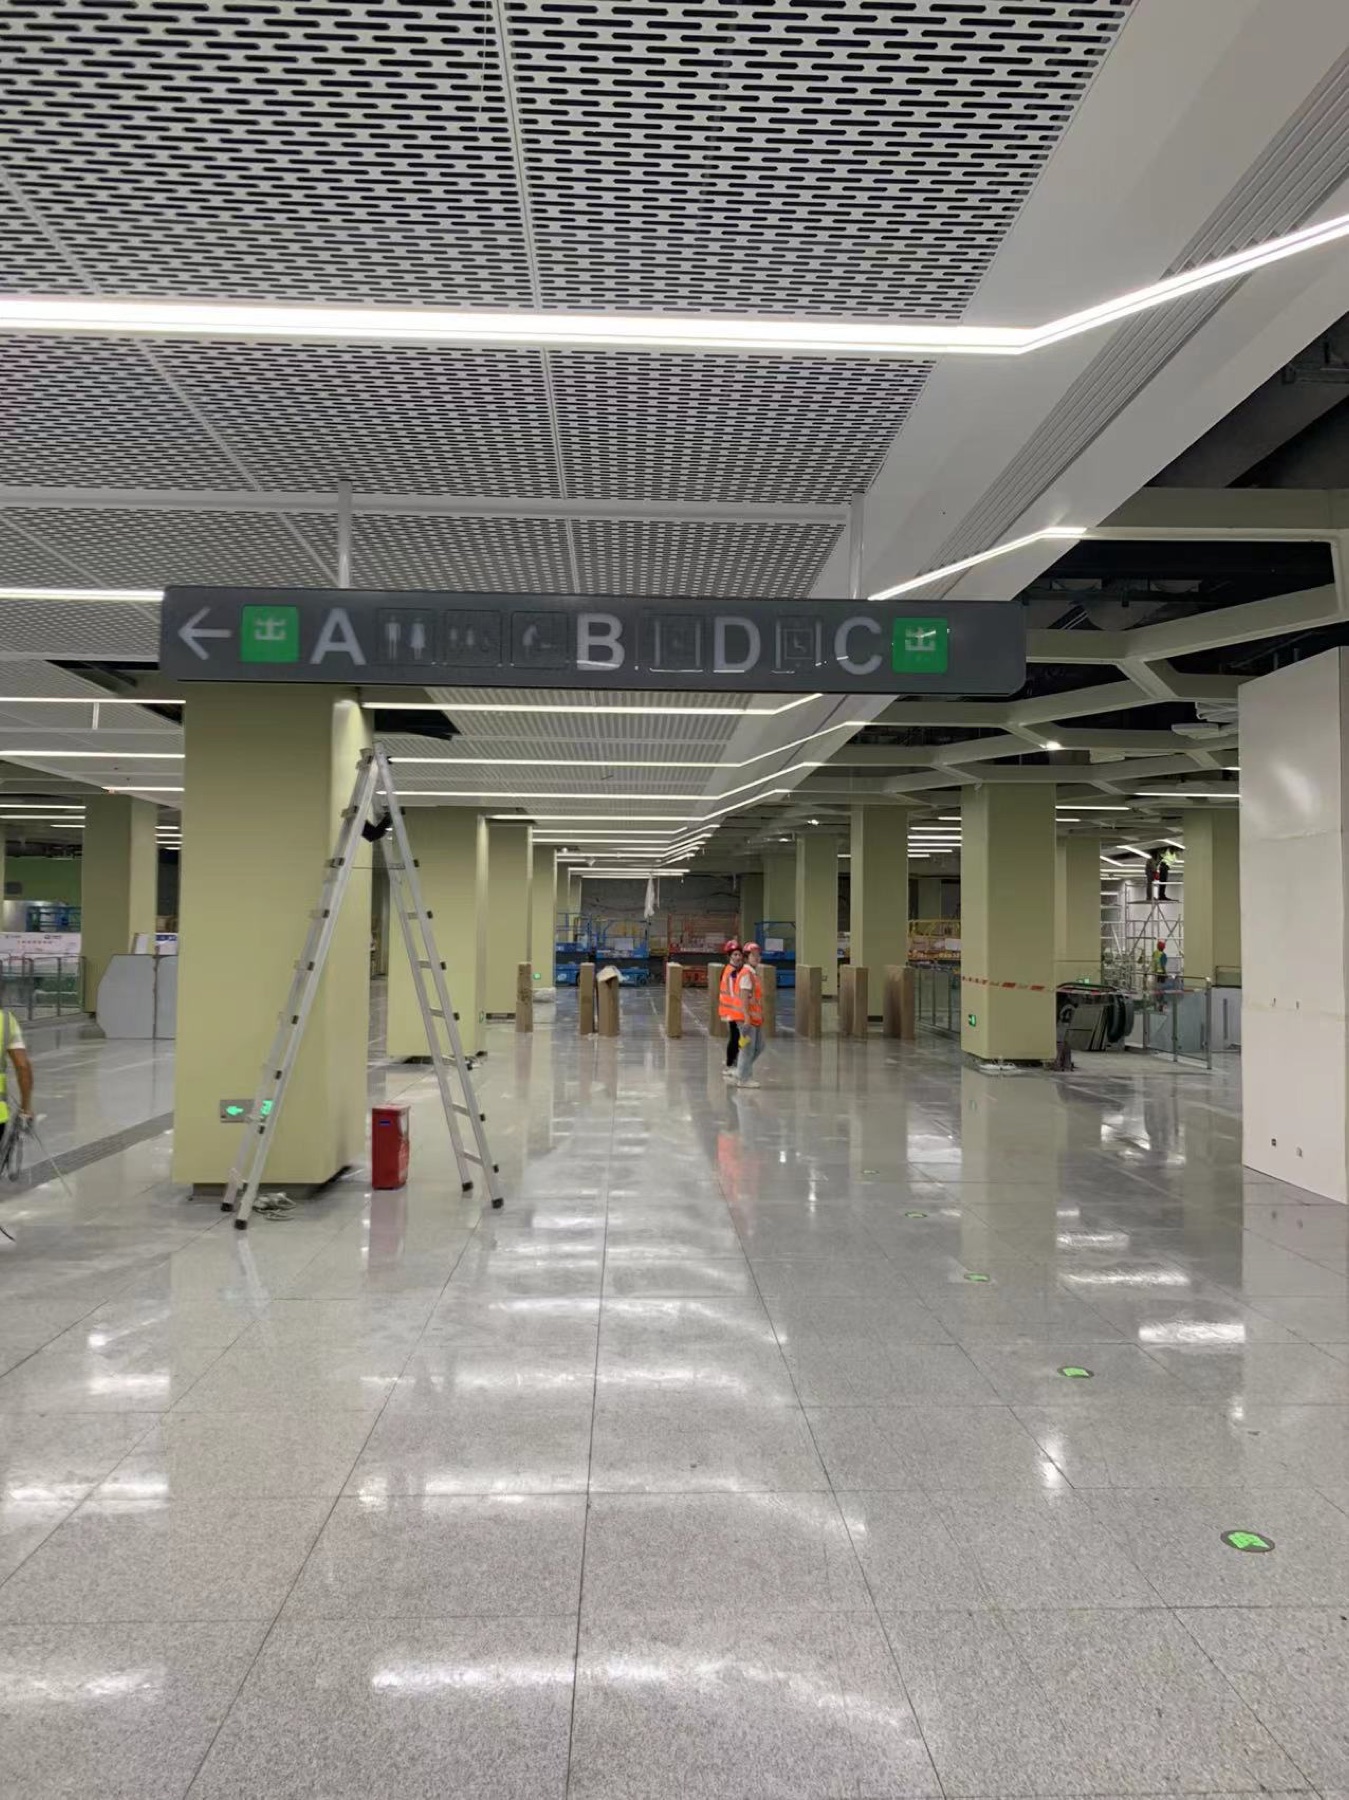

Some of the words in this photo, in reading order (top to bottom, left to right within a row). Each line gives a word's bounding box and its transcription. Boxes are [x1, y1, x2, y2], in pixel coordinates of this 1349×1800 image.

[310, 608, 366, 667] A
[576, 613, 626, 672] B
[713, 616, 761, 674] D
[833, 617, 883, 676] C
